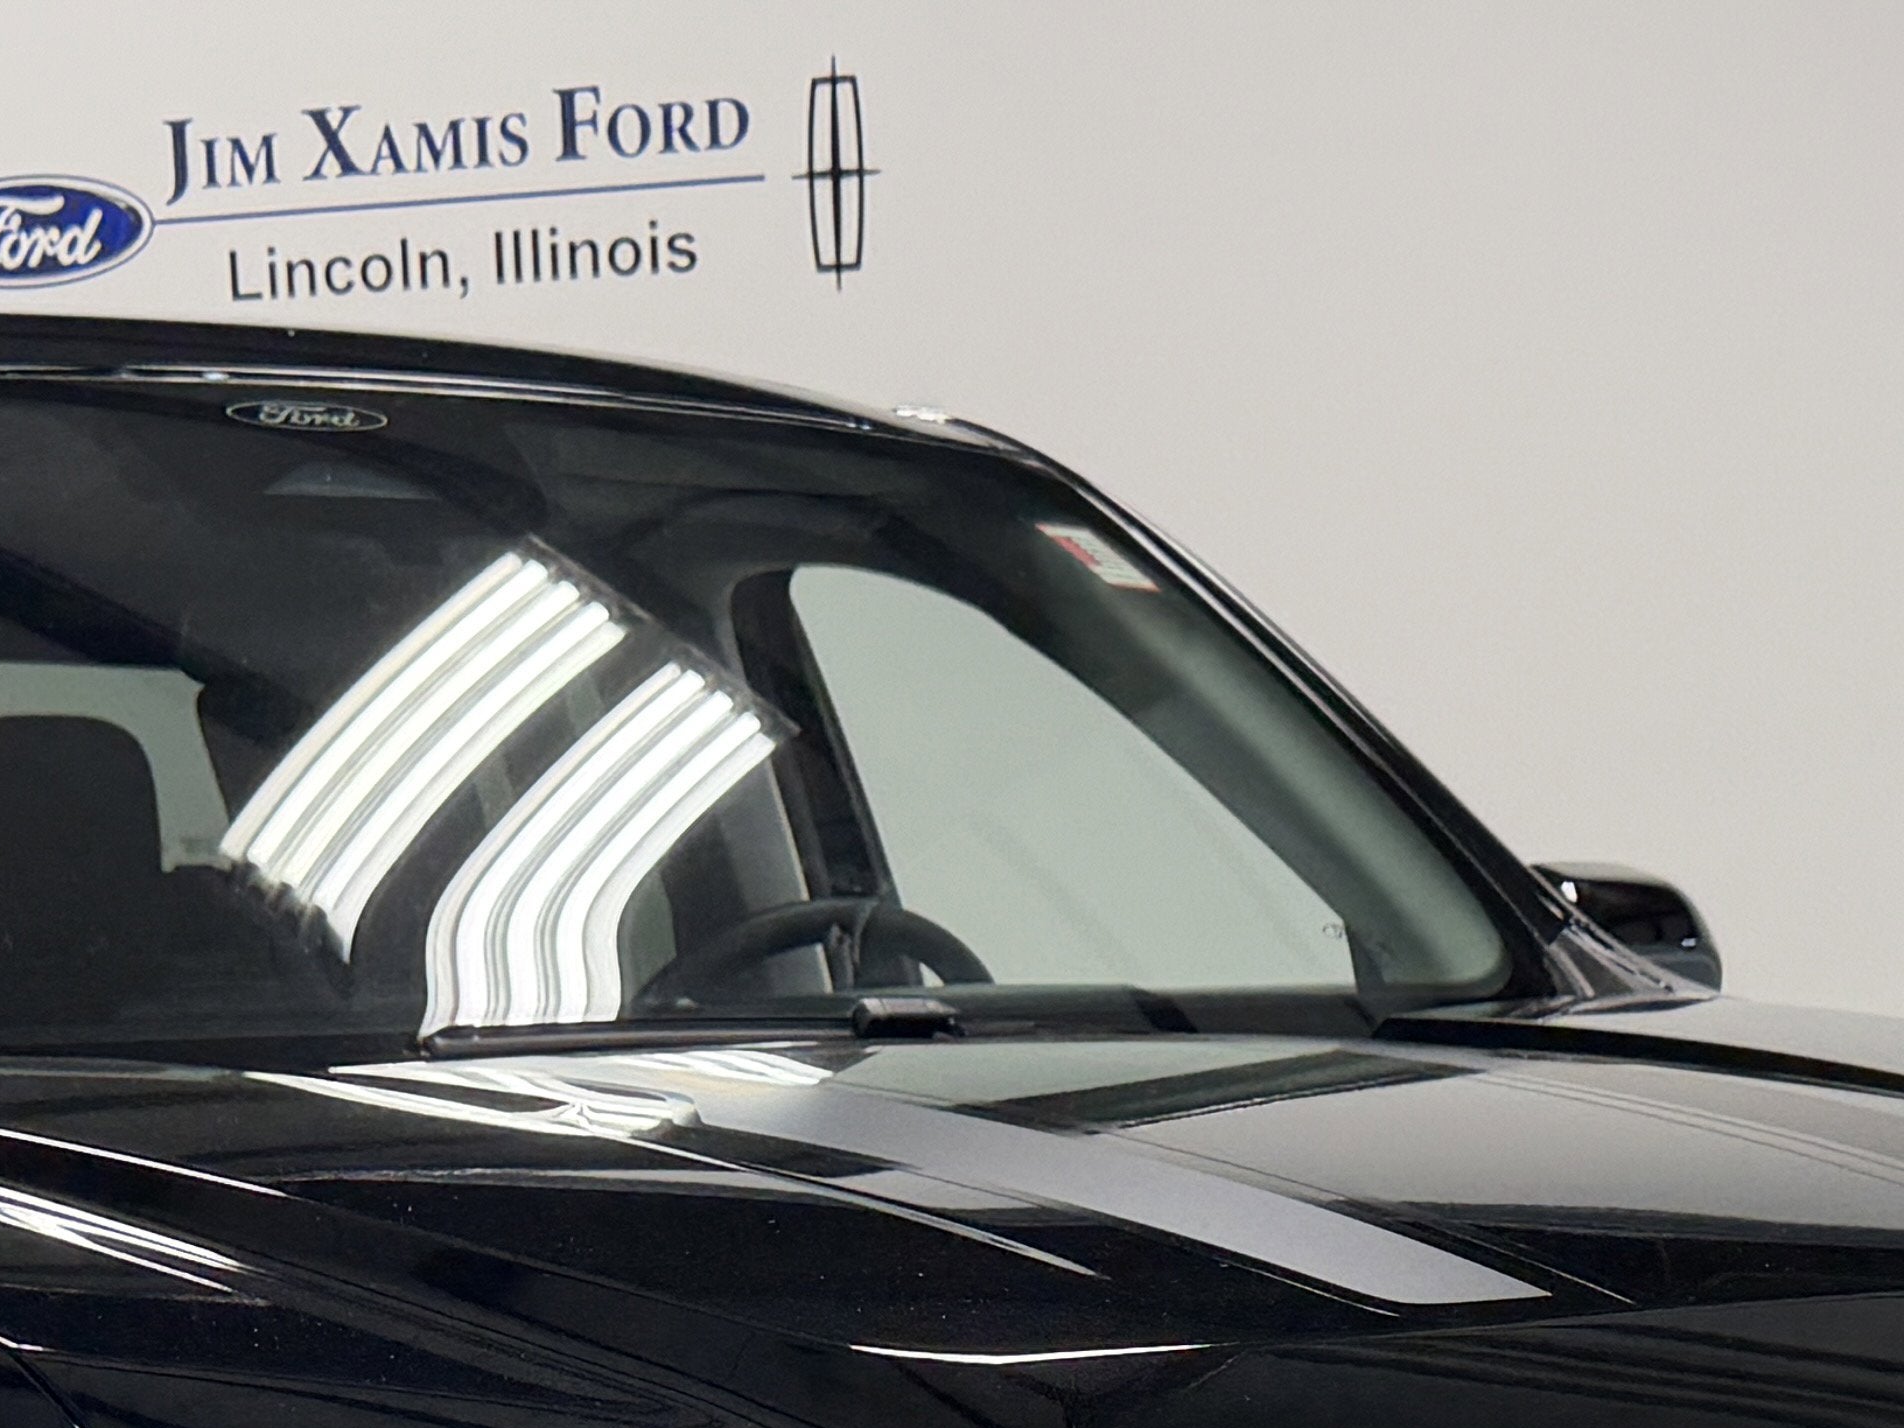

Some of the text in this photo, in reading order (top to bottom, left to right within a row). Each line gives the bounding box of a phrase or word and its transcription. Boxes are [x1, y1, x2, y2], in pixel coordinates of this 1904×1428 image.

[162, 85, 750, 206] JIM XAMIS FORD
[228, 219, 698, 301] Lincoln, Illinois
[258, 402, 360, 428] Ford
